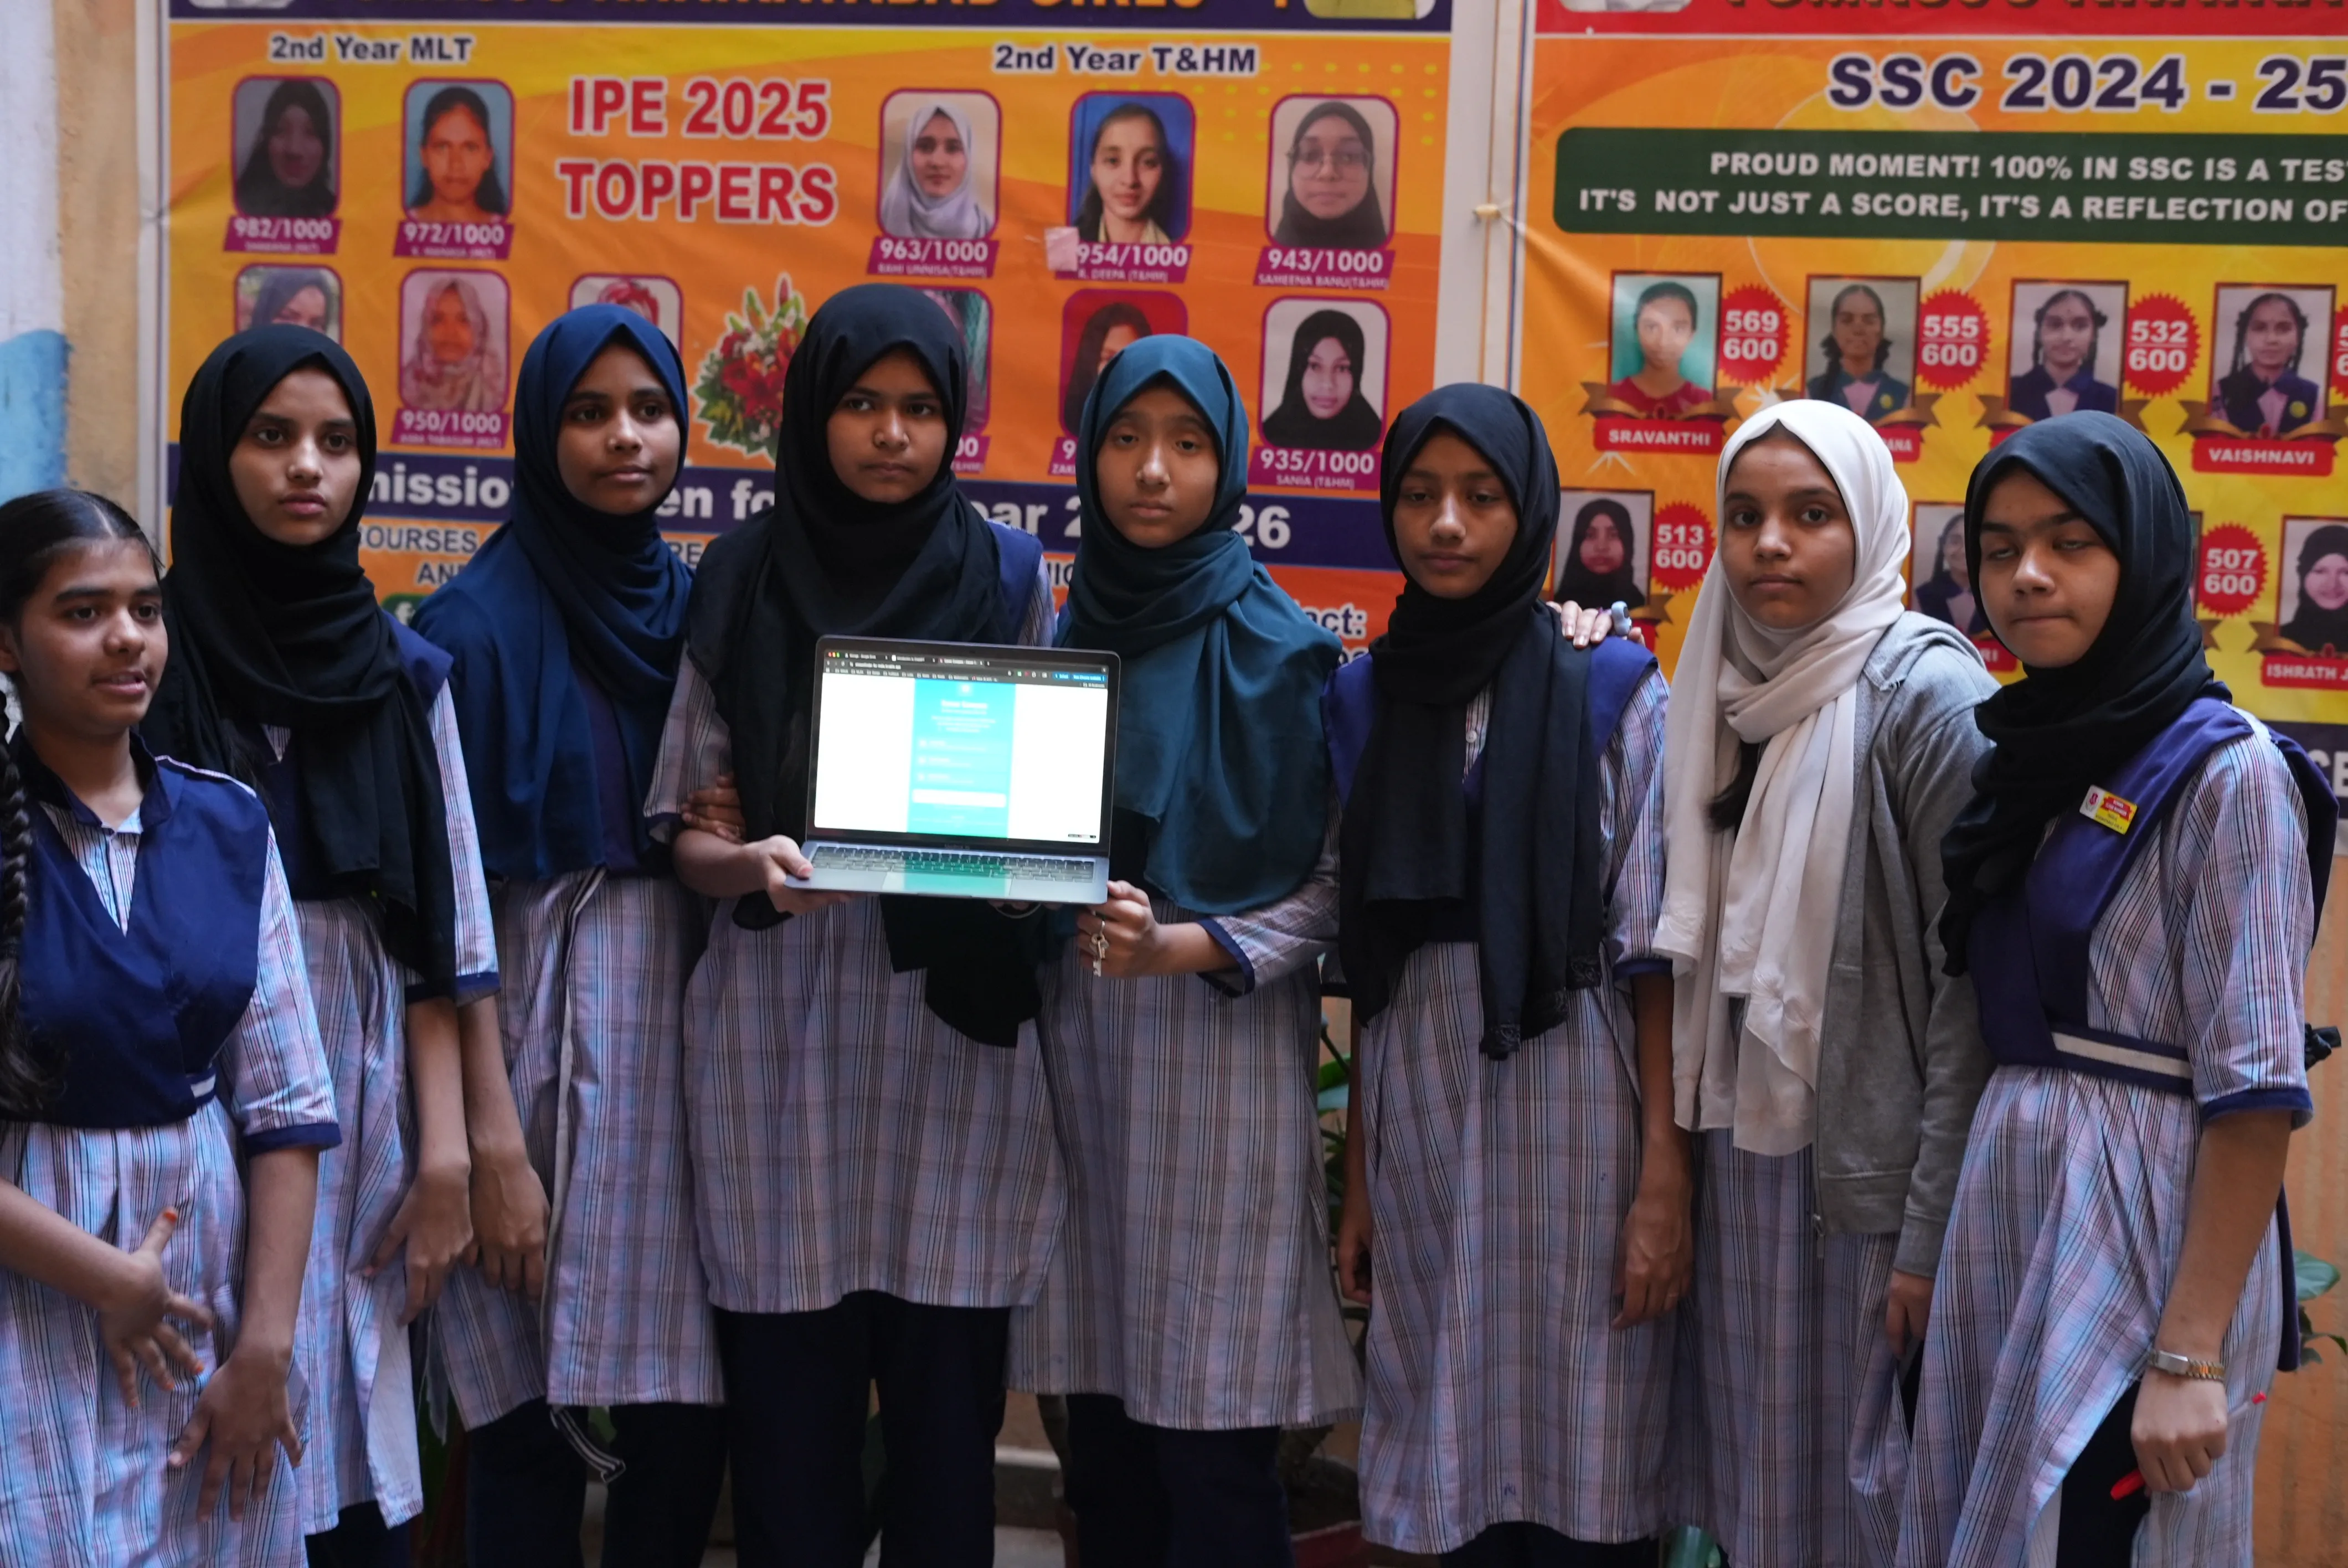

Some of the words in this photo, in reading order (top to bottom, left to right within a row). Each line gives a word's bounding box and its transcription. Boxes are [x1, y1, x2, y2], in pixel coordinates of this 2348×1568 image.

[270, 35, 324, 60] 2nd
[337, 37, 400, 60] Year
[411, 38, 472, 60] MLT
[995, 44, 1056, 71] 2nd
[1067, 46, 1141, 73] Year
[1152, 47, 1257, 74] T&HM
[1829, 55, 1981, 108] SSC
[2002, 56, 2185, 110] 2024
[2254, 57, 2347, 111] 25
[571, 79, 665, 133] IPE
[684, 80, 830, 137] 2025
[1710, 153, 1820, 176] PROUD
[1829, 154, 1980, 178] MOMENT!
[1990, 156, 2073, 180] 100%
[2083, 157, 2118, 179] IN
[2128, 157, 2194, 181] SSC
[2203, 158, 2236, 182] IS
[2246, 159, 2270, 182] A
[2280, 159, 2348, 182] TES
[558, 162, 836, 223] TOPPERS
[1579, 188, 1637, 212] IT'S
[1655, 190, 1720, 213] NOT
[1728, 192, 1811, 214] JUST
[1820, 193, 1842, 215] A
[1851, 194, 1970, 221] SCORE,
[1980, 195, 2040, 218] IT'S
[2050, 197, 2073, 218] A
[2082, 197, 2293, 221] REFLECTION
[2304, 200, 2348, 222] OF
[234, 219, 333, 240] 982/1000
[403, 223, 505, 245] 972/1000
[879, 239, 990, 263] 963/1000
[1077, 244, 1189, 268] 954/1000
[1268, 248, 1384, 273] 943/1000
[1725, 310, 1779, 333] 569
[1923, 315, 1980, 339] 555
[2131, 319, 2189, 343] 532
[1723, 338, 1778, 361] 600
[1921, 343, 1978, 367] 600
[2129, 349, 2186, 372] 600
[401, 410, 502, 434] 950/1000
[1608, 430, 1712, 446] SRAVANTHI
[1260, 449, 1375, 475] 935/1000
[2208, 448, 2316, 465] VAISHNAVI
[1657, 524, 1705, 545] 513
[1655, 549, 1704, 570] 600
[2206, 548, 2258, 570] 507
[2204, 574, 2256, 595] 600
[2266, 663, 2337, 680] ISHRATH
